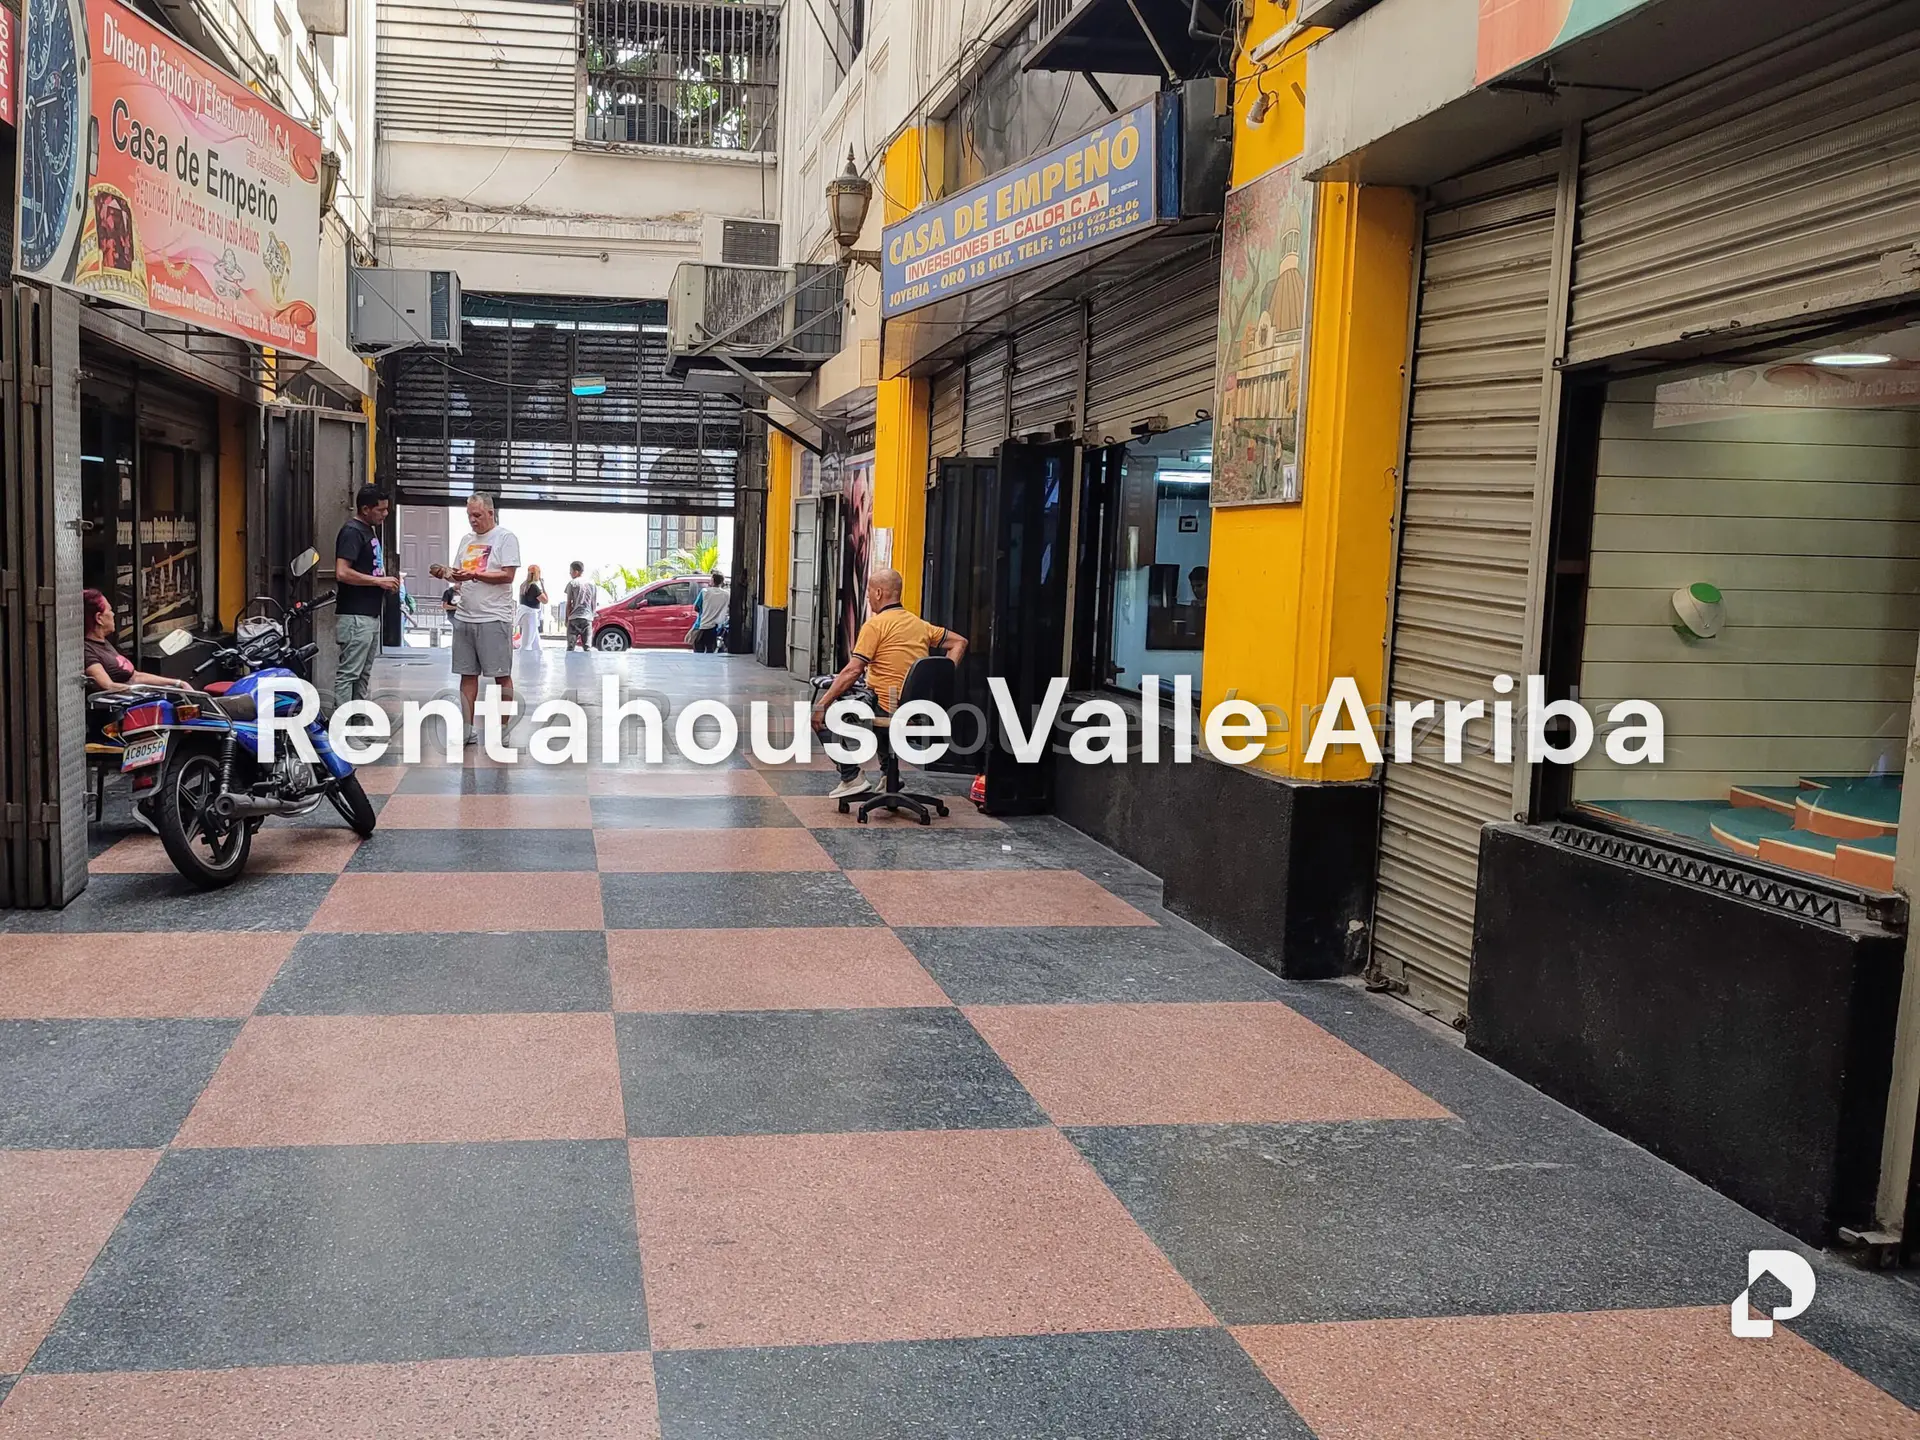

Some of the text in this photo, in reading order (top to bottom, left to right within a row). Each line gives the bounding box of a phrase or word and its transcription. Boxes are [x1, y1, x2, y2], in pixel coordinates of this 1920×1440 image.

[103, 12, 147, 77] Dinero
[150, 43, 192, 103] Rápido
[194, 83, 202, 120] y
[204, 78, 246, 136] Efectivo
[112, 97, 168, 173] Casa
[176, 136, 200, 187] de
[207, 149, 278, 225] Empeño
[889, 126, 1139, 265] CASA DE EMPEÑO
[889, 281, 930, 307] JOYERIA
[940, 267, 966, 289] ORO
[970, 260, 985, 278] 18
[989, 250, 1014, 271] KLT.
[1018, 235, 1053, 260] TELF:
[908, 190, 1105, 281] INVERSIONES EL CALOR C.A.
[1059, 221, 1084, 237] 0416
[1059, 232, 1084, 247] 0414
